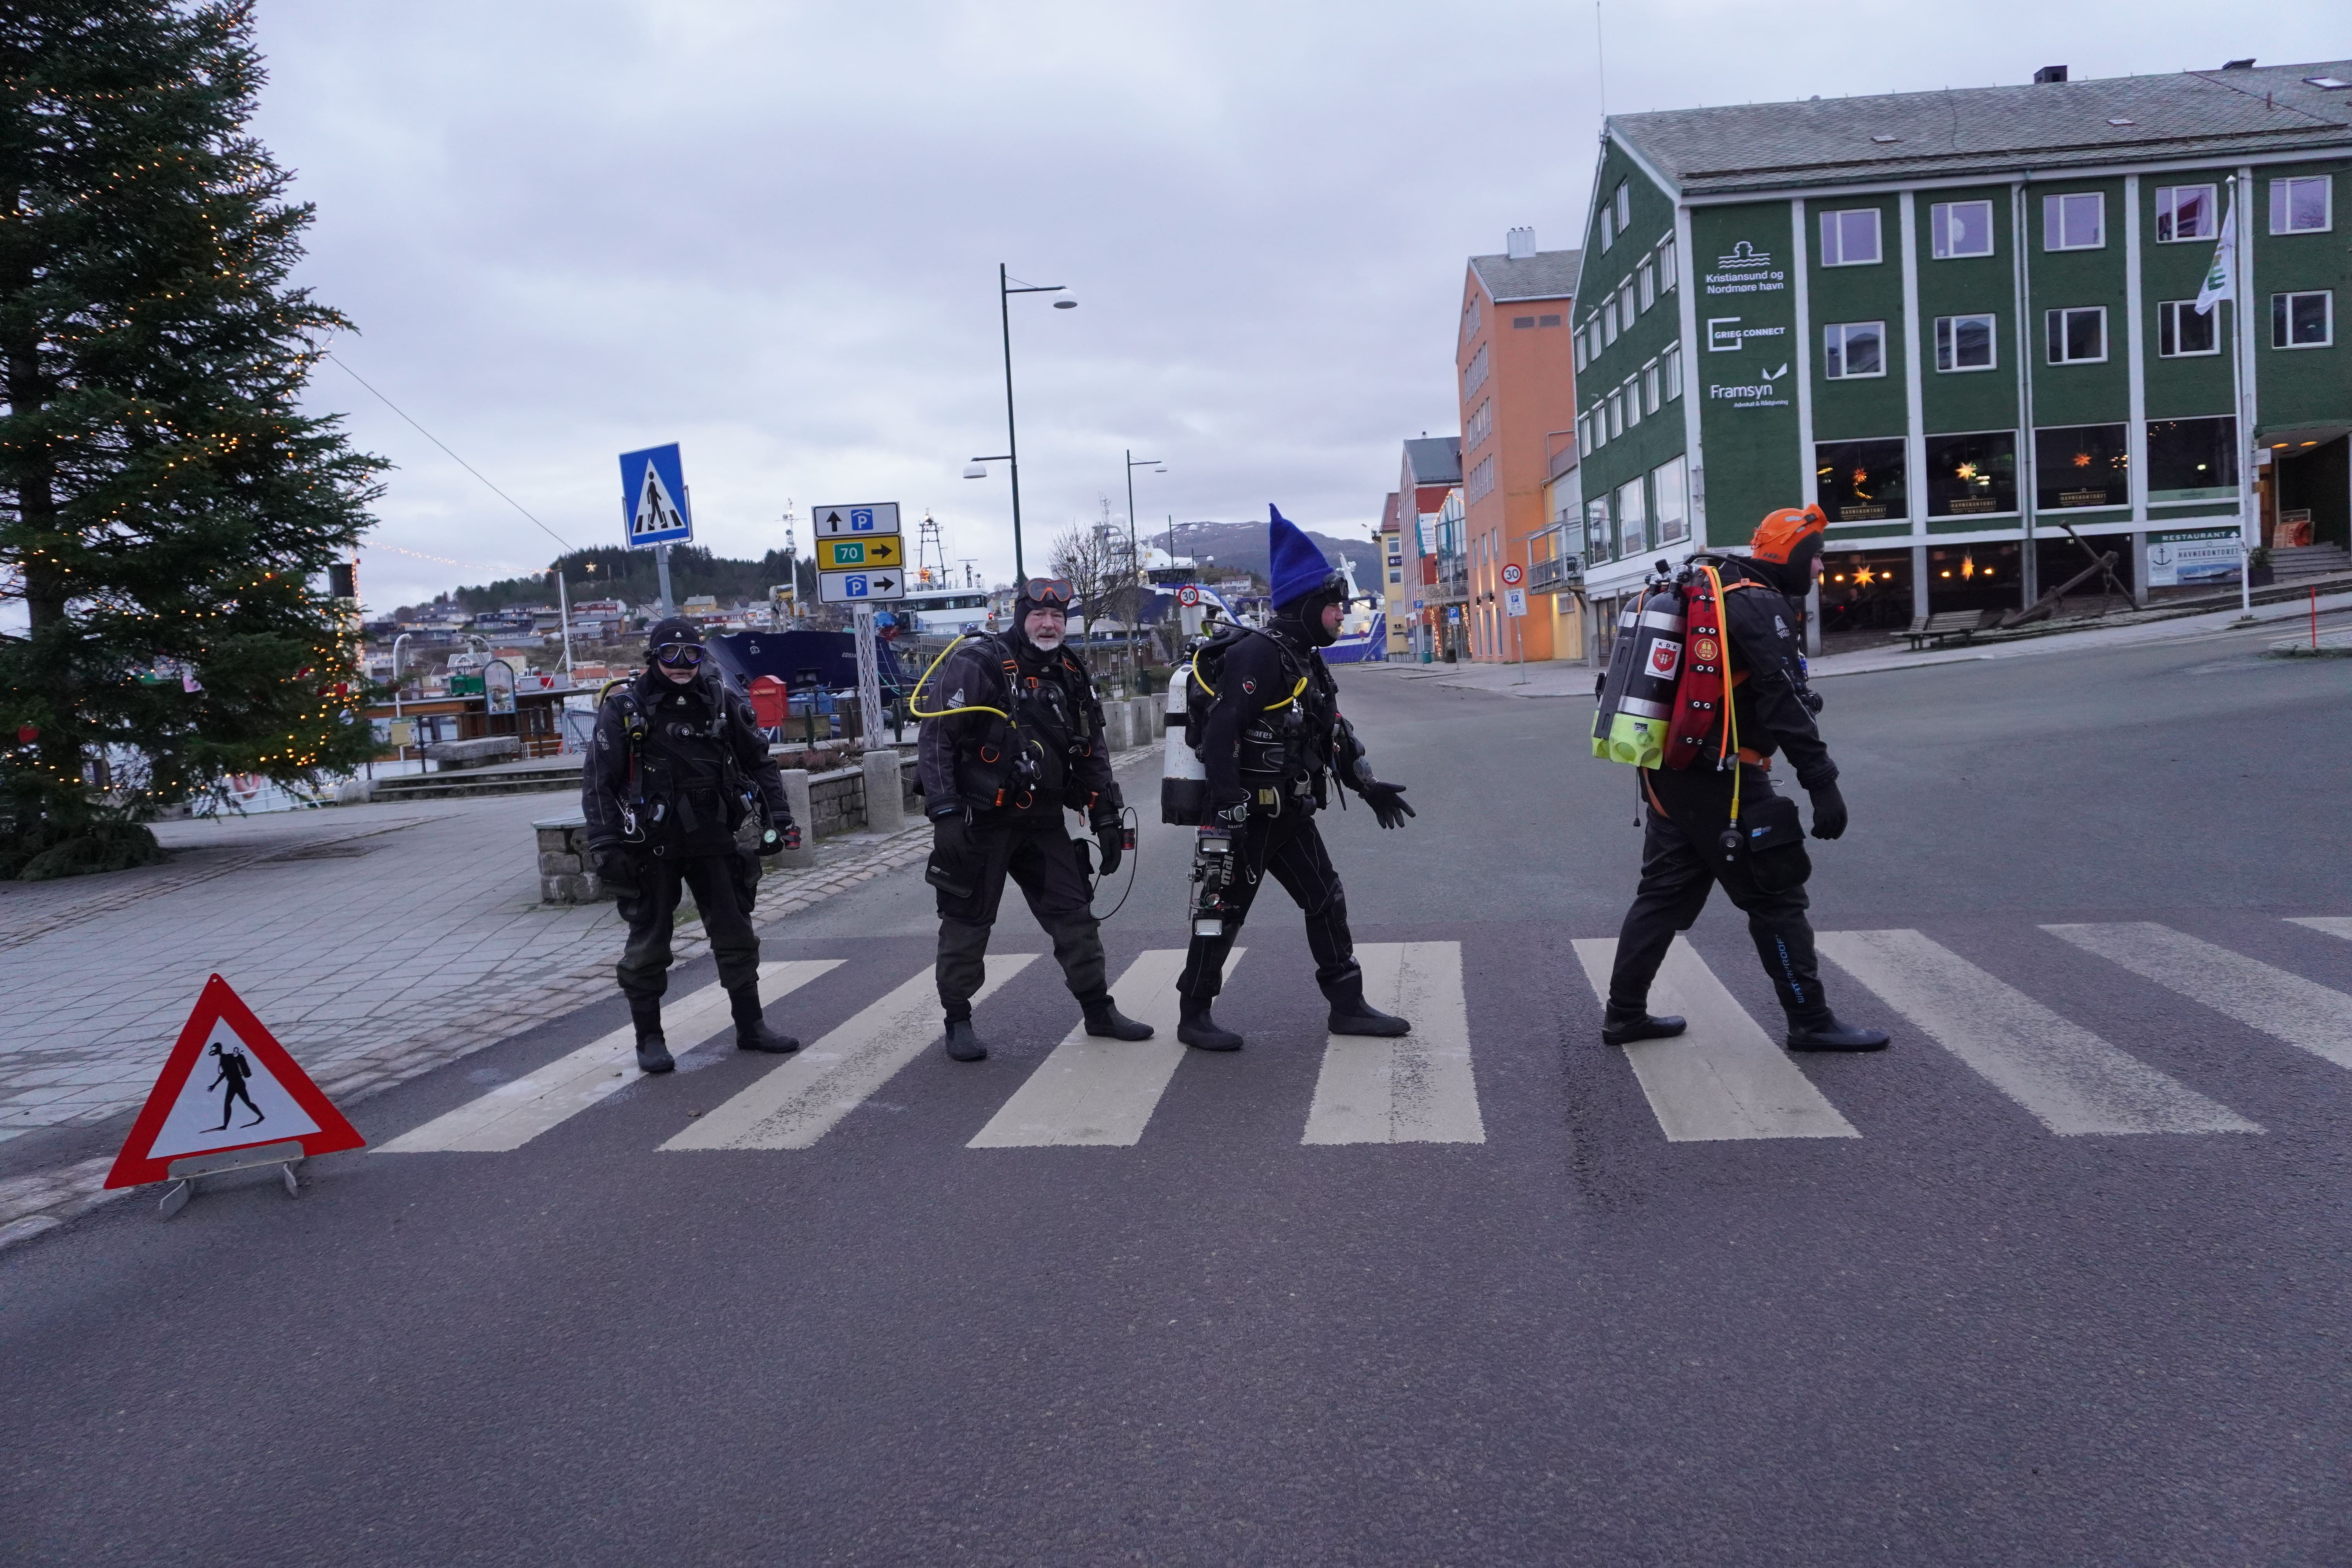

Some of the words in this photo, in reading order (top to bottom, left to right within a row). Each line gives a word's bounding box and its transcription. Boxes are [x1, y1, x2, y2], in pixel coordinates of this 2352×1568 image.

[1706, 271, 1768, 283] Kristiansund
[1771, 271, 1784, 280] og
[1707, 283, 1757, 294] Nordmøre
[1760, 282, 1784, 291] havn
[1715, 330, 1742, 339] GRIEG
[1743, 327, 1785, 338] CONNECT
[1711, 384, 1773, 399] Framsyn
[858, 515, 867, 529] P
[2162, 531, 2226, 541] RESTAURANT
[840, 547, 858, 559] 70
[2178, 548, 2239, 558] HAVNEKONTORET
[1506, 568, 1519, 580] 30
[852, 581, 862, 595] P
[1182, 591, 1196, 602] 30
[1450, 608, 1456, 617] P
[1246, 729, 1273, 739] mares
